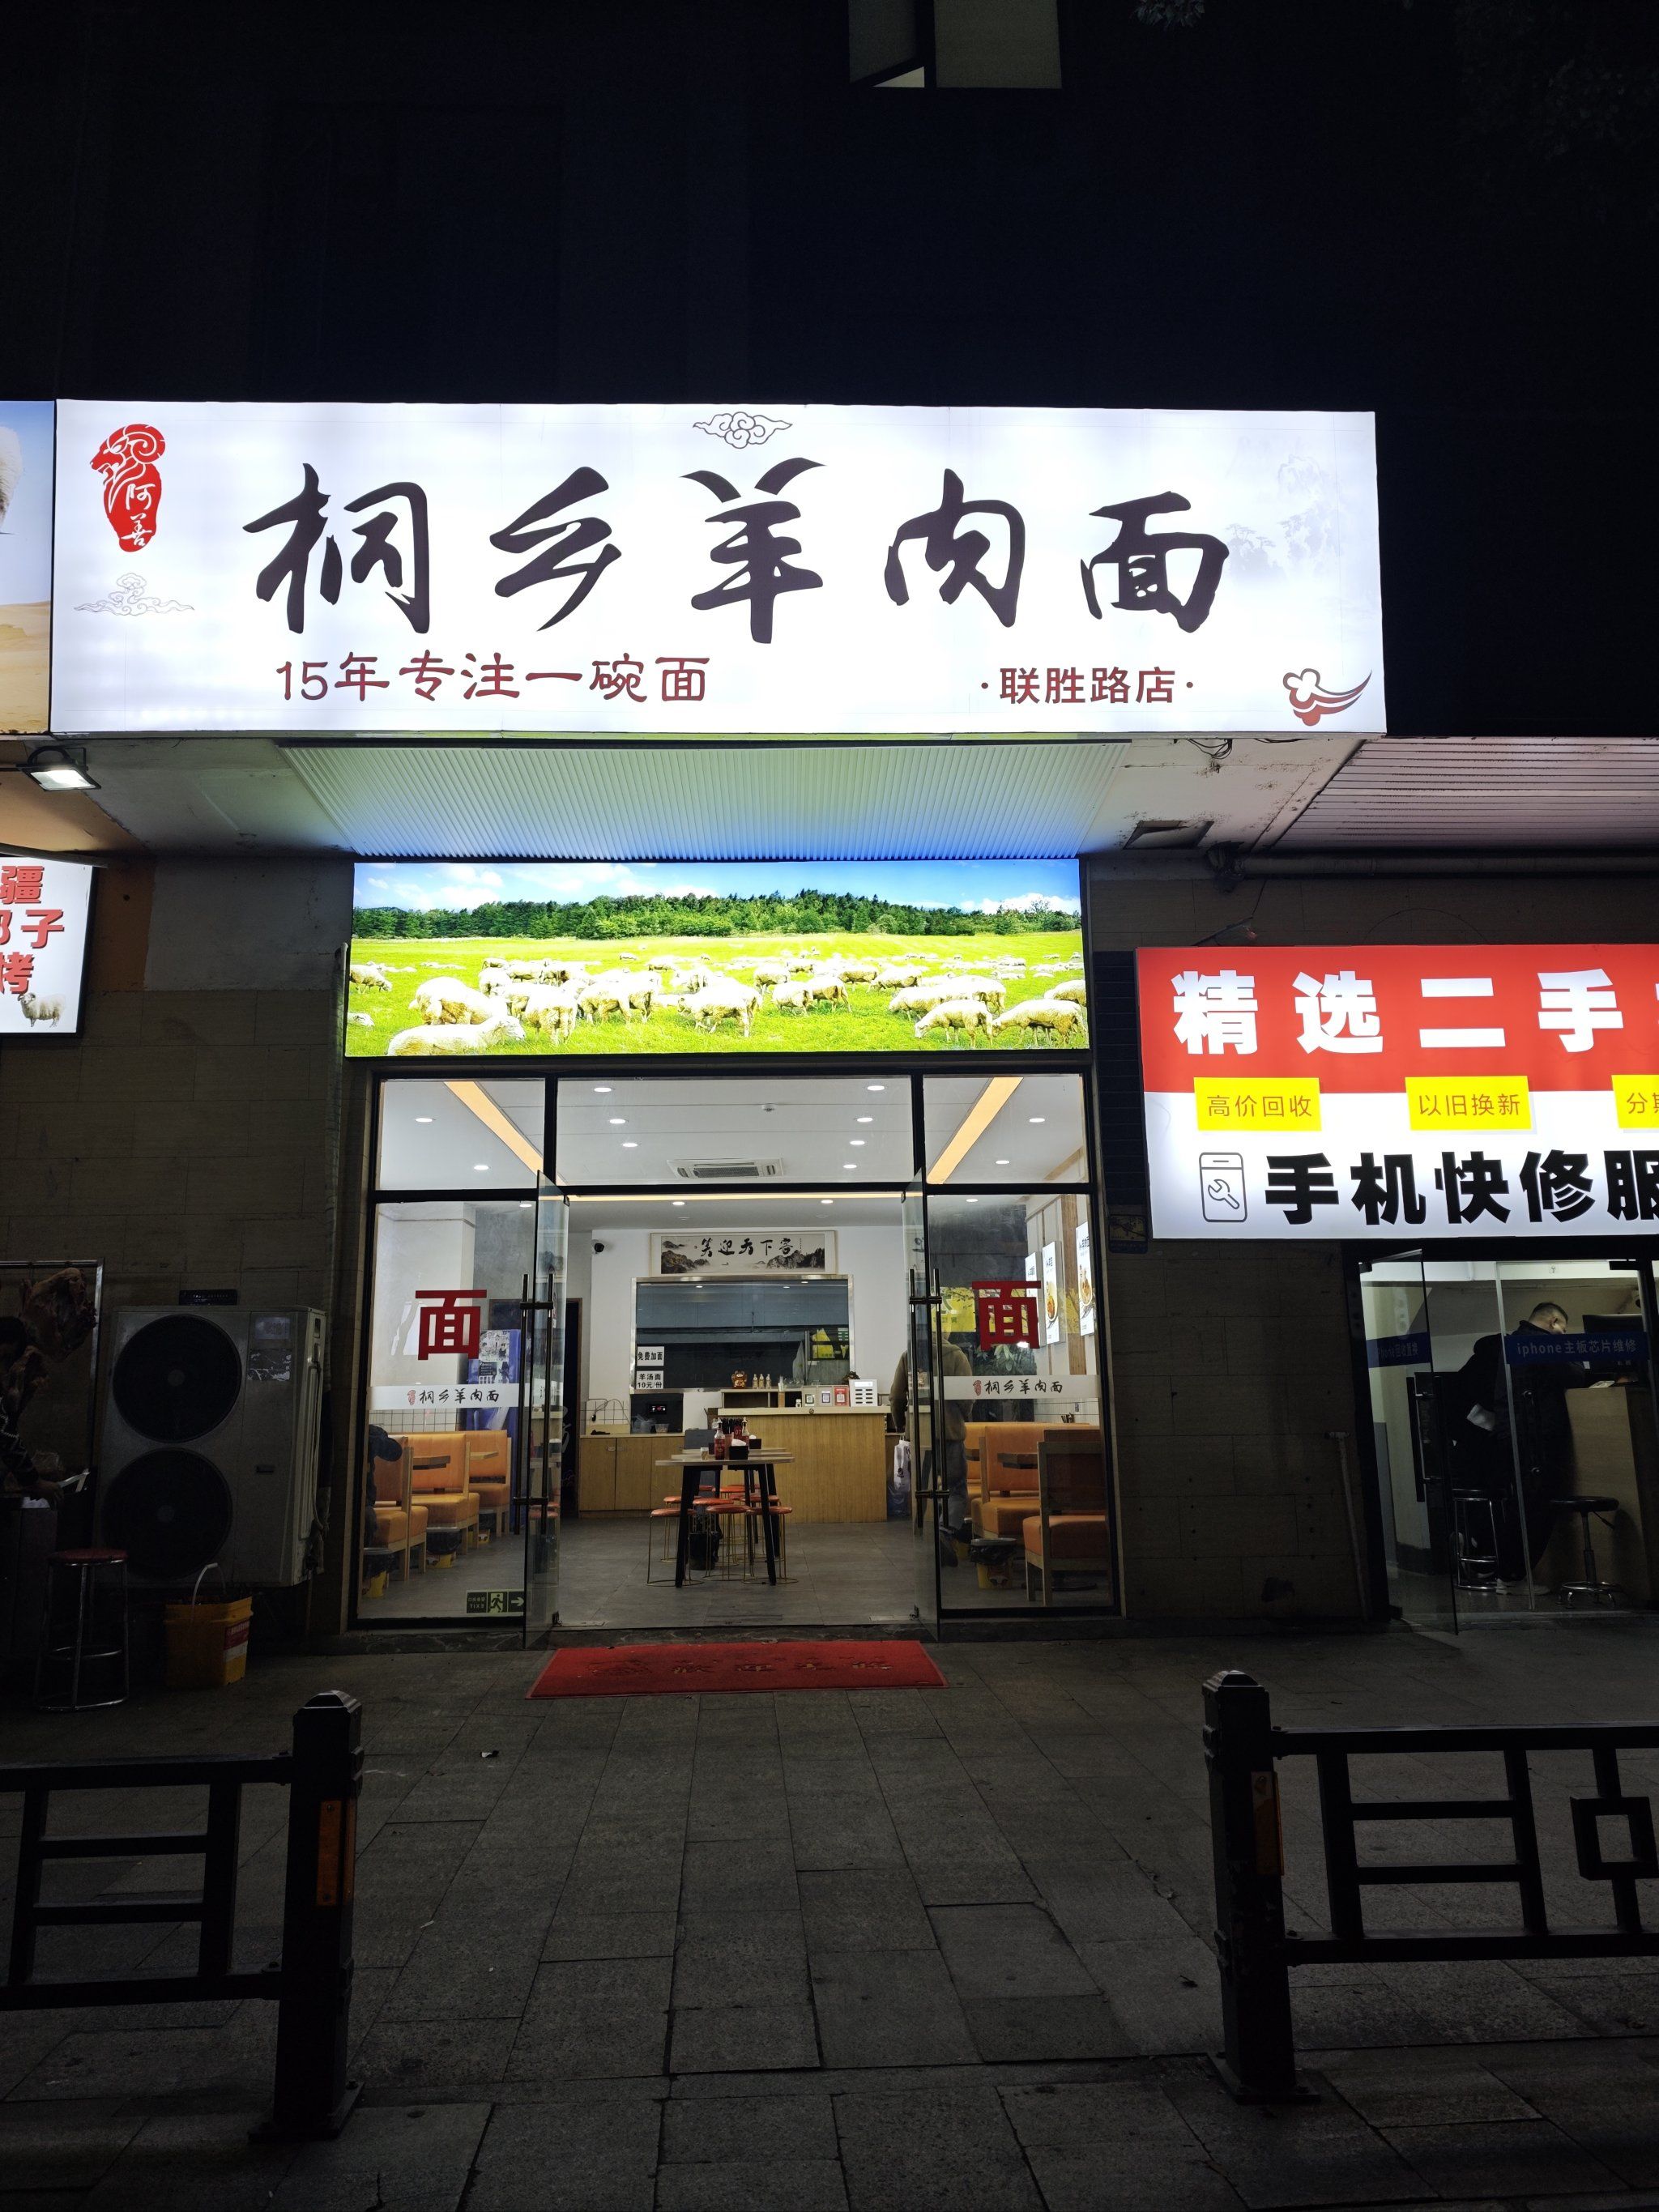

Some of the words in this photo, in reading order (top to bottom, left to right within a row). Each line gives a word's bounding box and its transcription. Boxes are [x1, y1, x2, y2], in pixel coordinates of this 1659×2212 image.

[243, 458, 1229, 643] 桐乡羊肉面
[276, 649, 710, 703] 15年专注一碗面
[1171, 968, 1659, 1055] 精选二手
[1207, 1094, 1312, 1118] 高价回收
[1418, 1093, 1520, 1116] 以旧换新
[416, 1290, 487, 1361] 面
[972, 1281, 1041, 1350] 面
[638, 1352, 663, 1361] 免费加面
[638, 1381, 663, 1389] 10元/份
[639, 1373, 662, 1381] 羊汤面
[984, 1379, 1064, 1397] 桐乡羊肉面
[419, 1388, 500, 1405] 桐乡羊肉面
